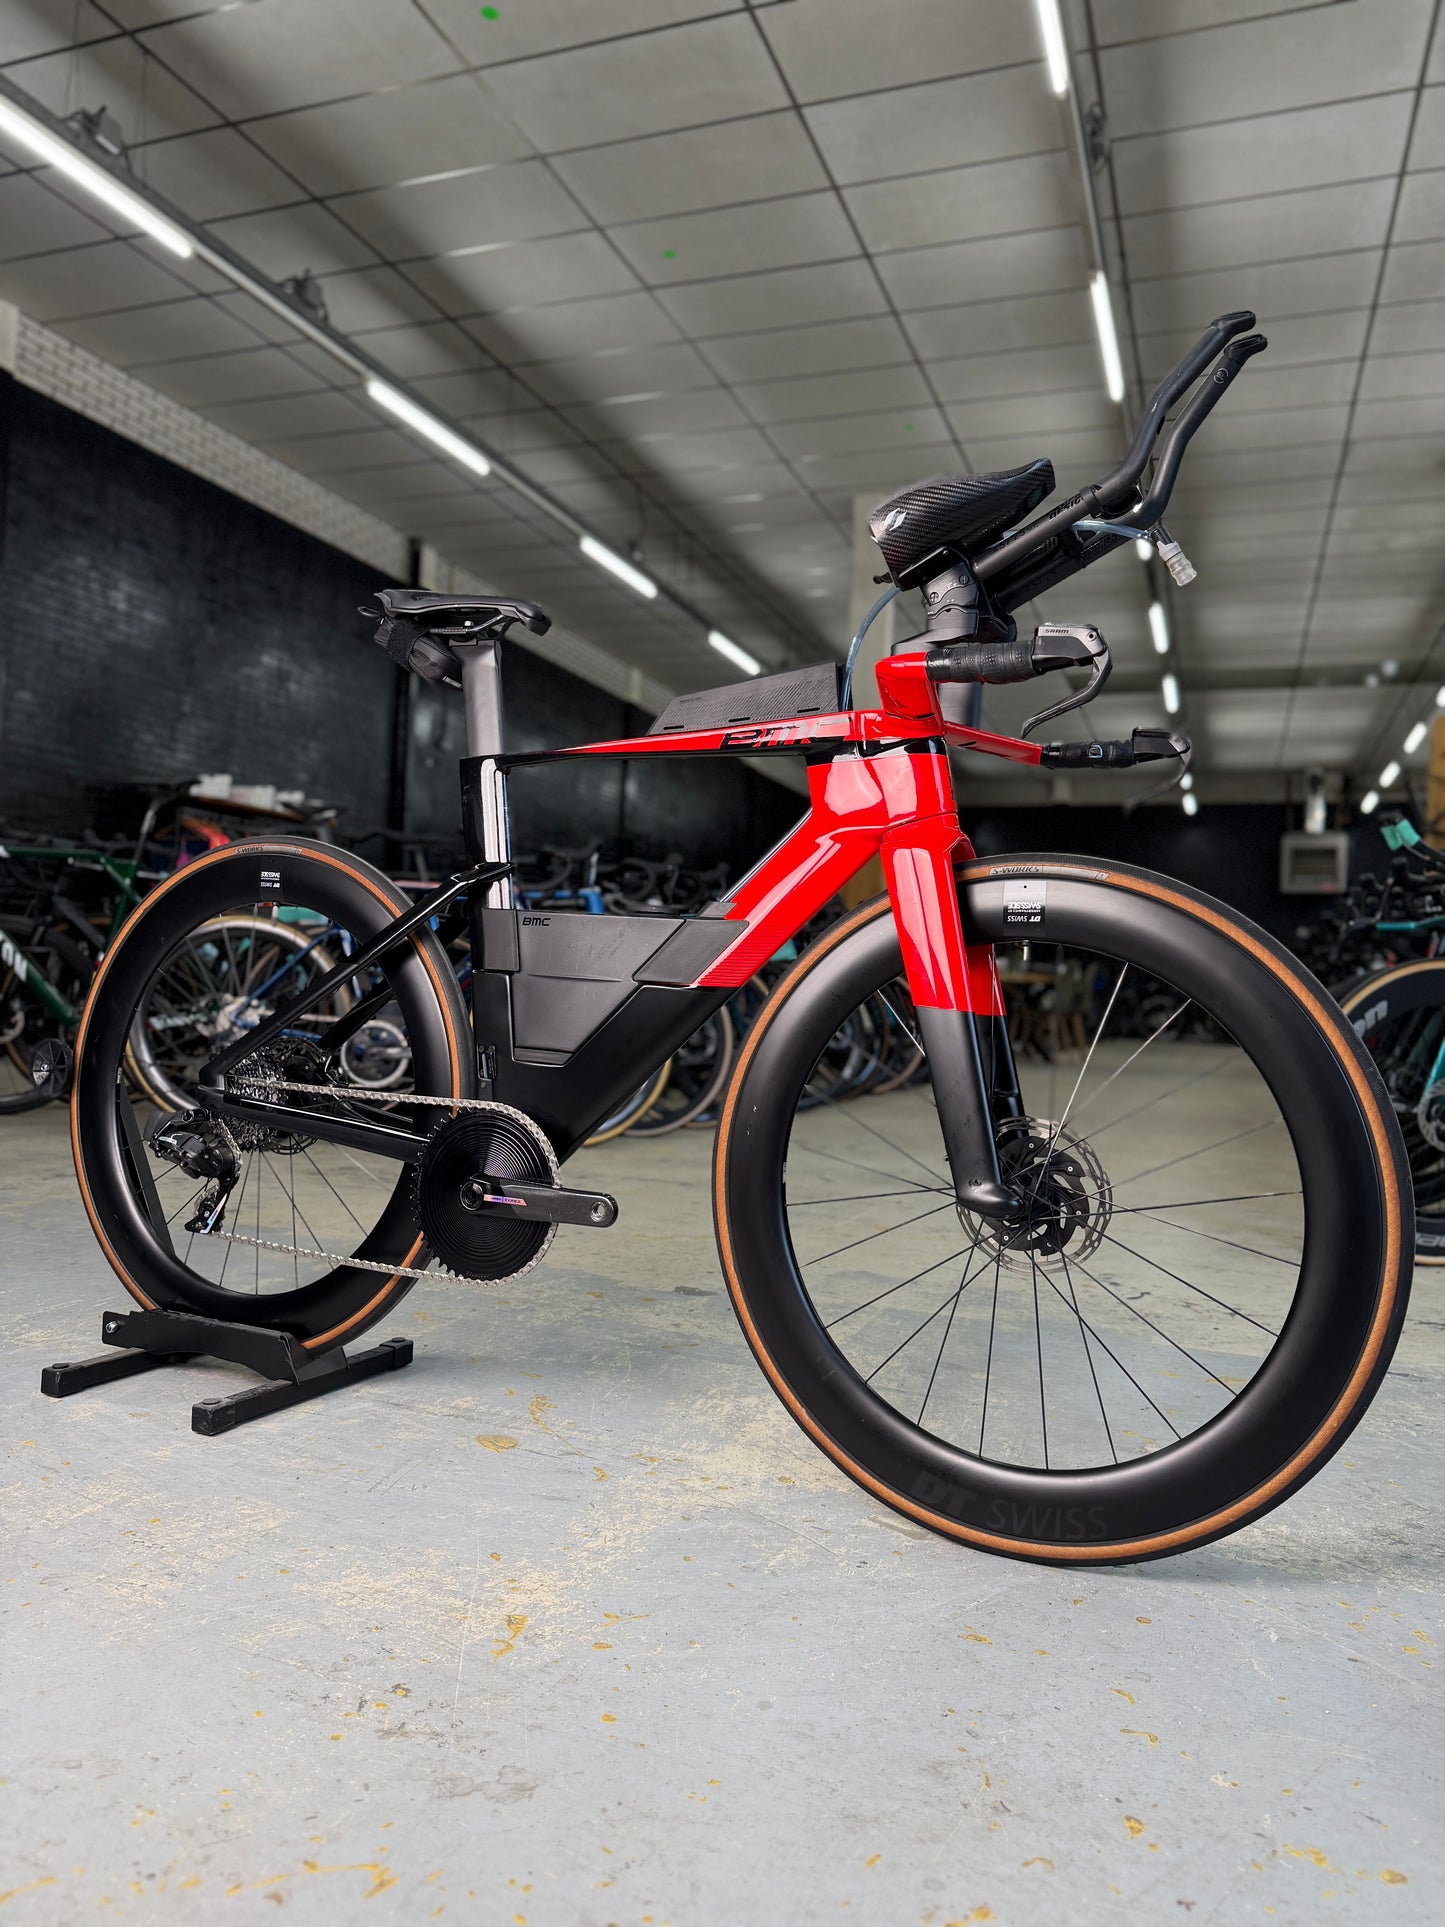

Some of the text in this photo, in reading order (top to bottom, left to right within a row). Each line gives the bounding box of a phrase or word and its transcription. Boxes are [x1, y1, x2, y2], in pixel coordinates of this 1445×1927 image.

[720, 717, 851, 750] BMC
[993, 865, 1039, 874] S-WORKS
[522, 917, 551, 926] BMC
[911, 1471, 1108, 1539] DT SWISS
